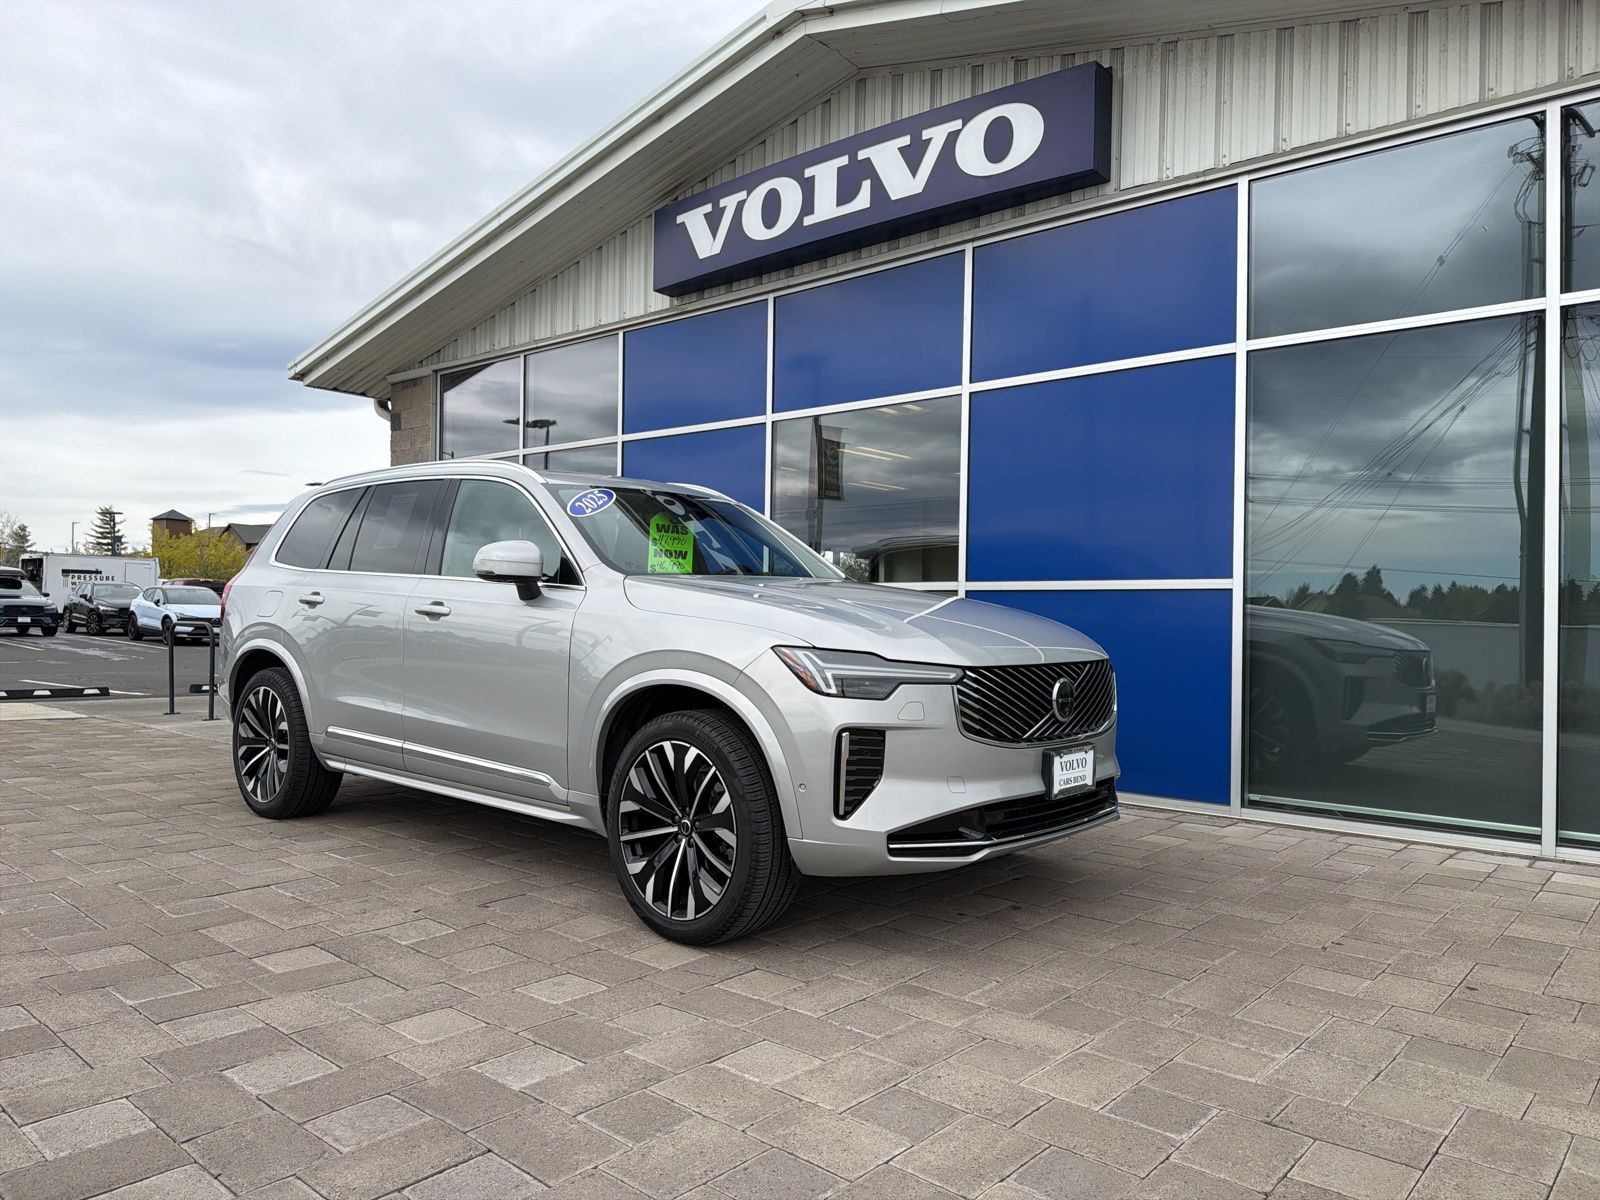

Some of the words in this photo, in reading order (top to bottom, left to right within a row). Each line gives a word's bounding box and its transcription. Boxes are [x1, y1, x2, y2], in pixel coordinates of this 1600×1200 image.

[676, 102, 1045, 259] VOLVO
[575, 490, 608, 513] 2025
[656, 523, 689, 535] WAS
[653, 548, 688, 560] NOW
[1060, 757, 1087, 772] VOLVO
[1059, 776, 1073, 786] CARS
[1073, 774, 1087, 784] BEND
